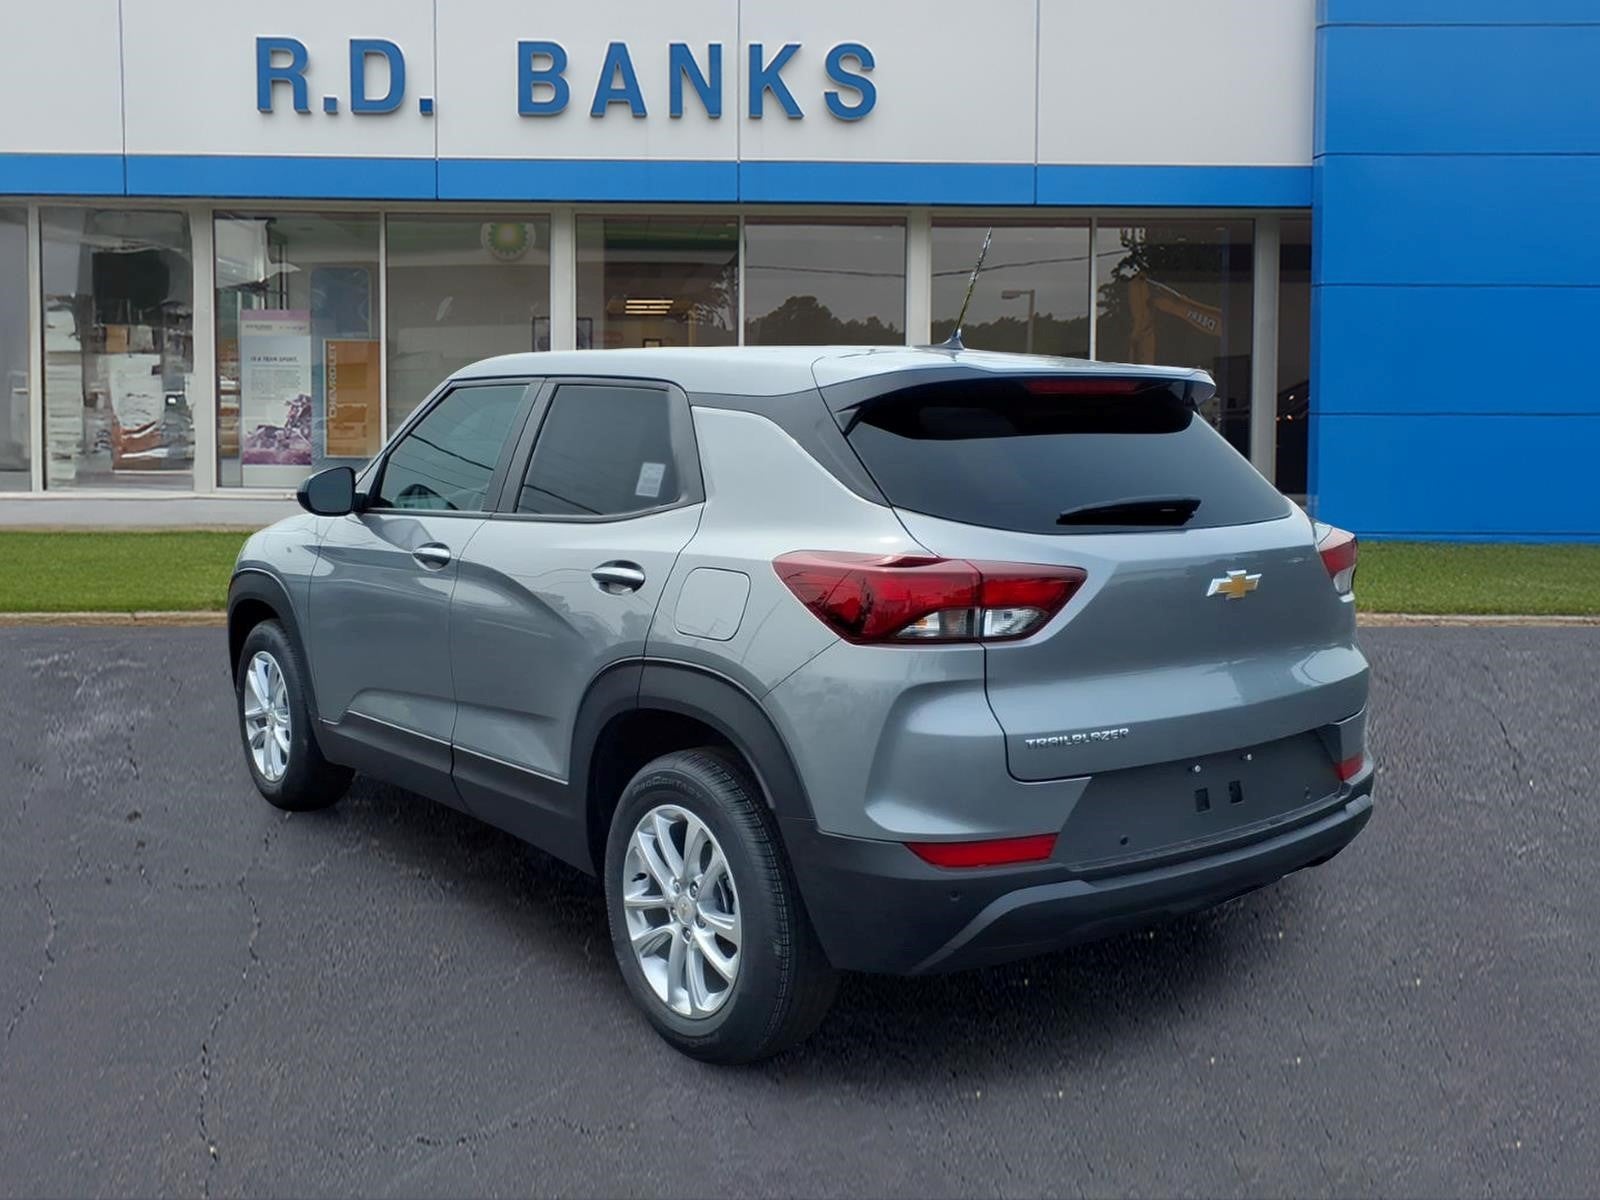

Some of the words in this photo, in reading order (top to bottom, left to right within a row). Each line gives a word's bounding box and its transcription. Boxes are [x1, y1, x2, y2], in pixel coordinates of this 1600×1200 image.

[256, 36, 433, 115] R.D.
[517, 40, 877, 121] BANKS
[1025, 727, 1129, 749] TRAILBLAZER
